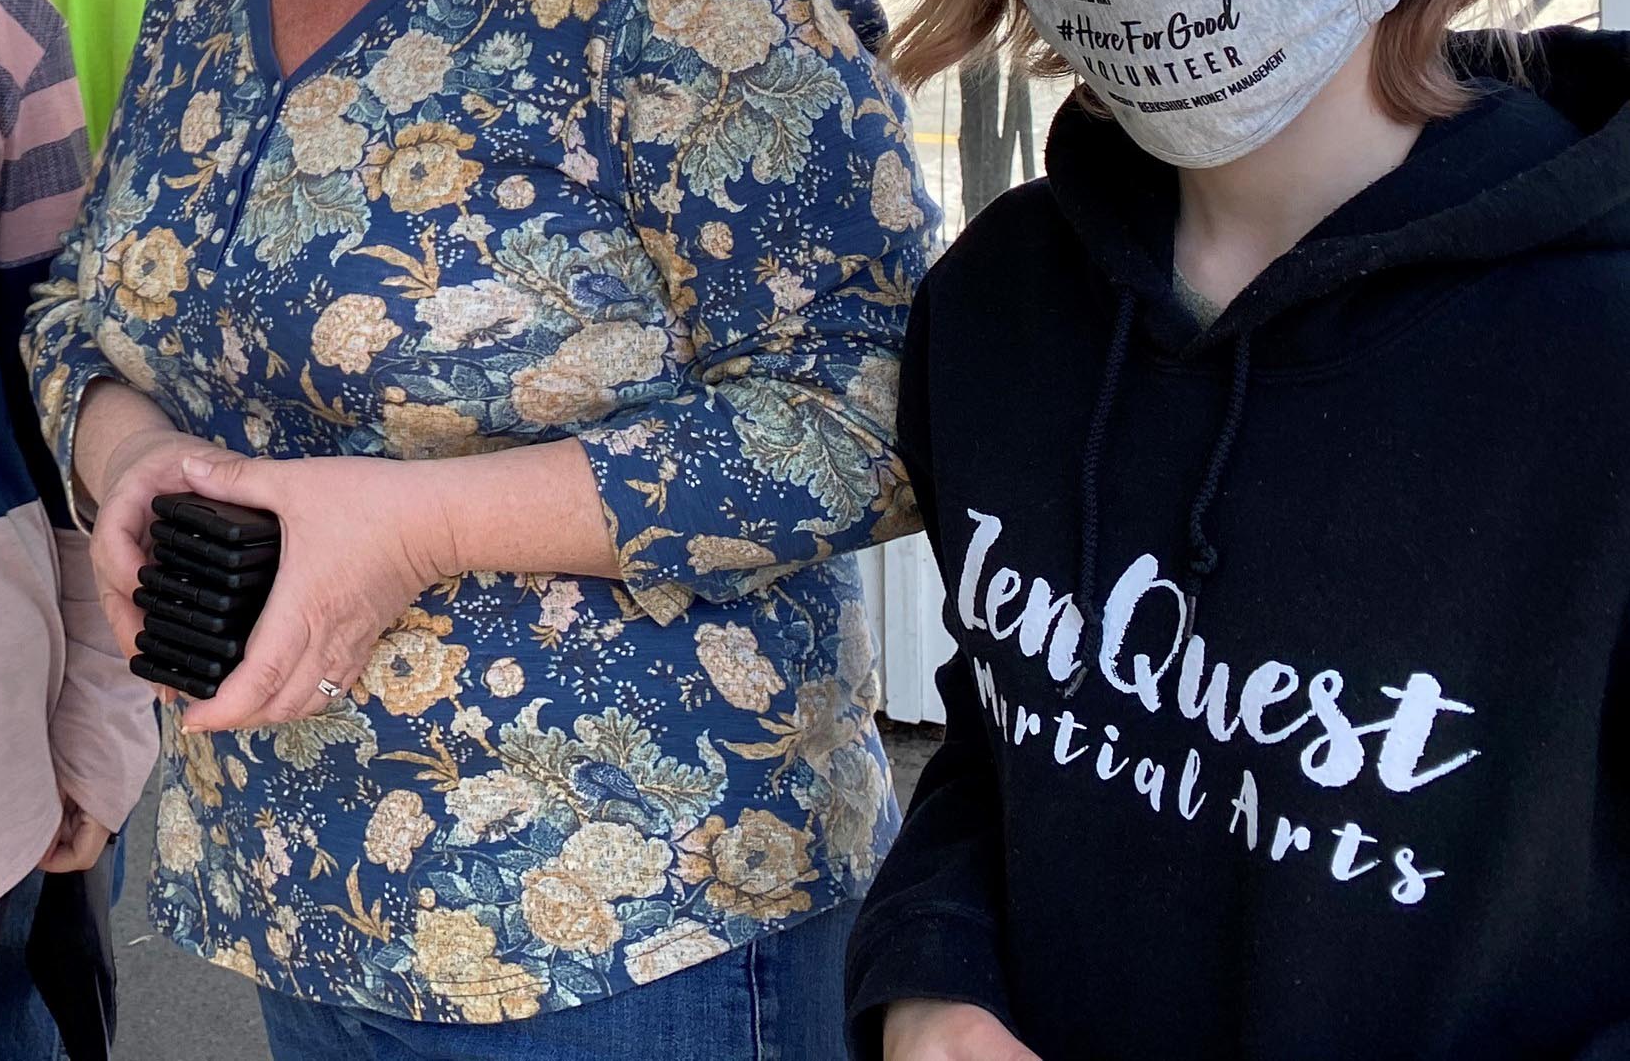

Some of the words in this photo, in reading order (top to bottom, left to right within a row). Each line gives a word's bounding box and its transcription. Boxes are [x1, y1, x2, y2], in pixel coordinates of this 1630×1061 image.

[1084, 46, 1243, 87] VOLUNTEER
[1138, 99, 1193, 113] BERKSHIRE
[1190, 88, 1229, 108] MONEY
[1224, 48, 1288, 96] MANAGEMENT
[1229, 769, 1445, 905] Arts
